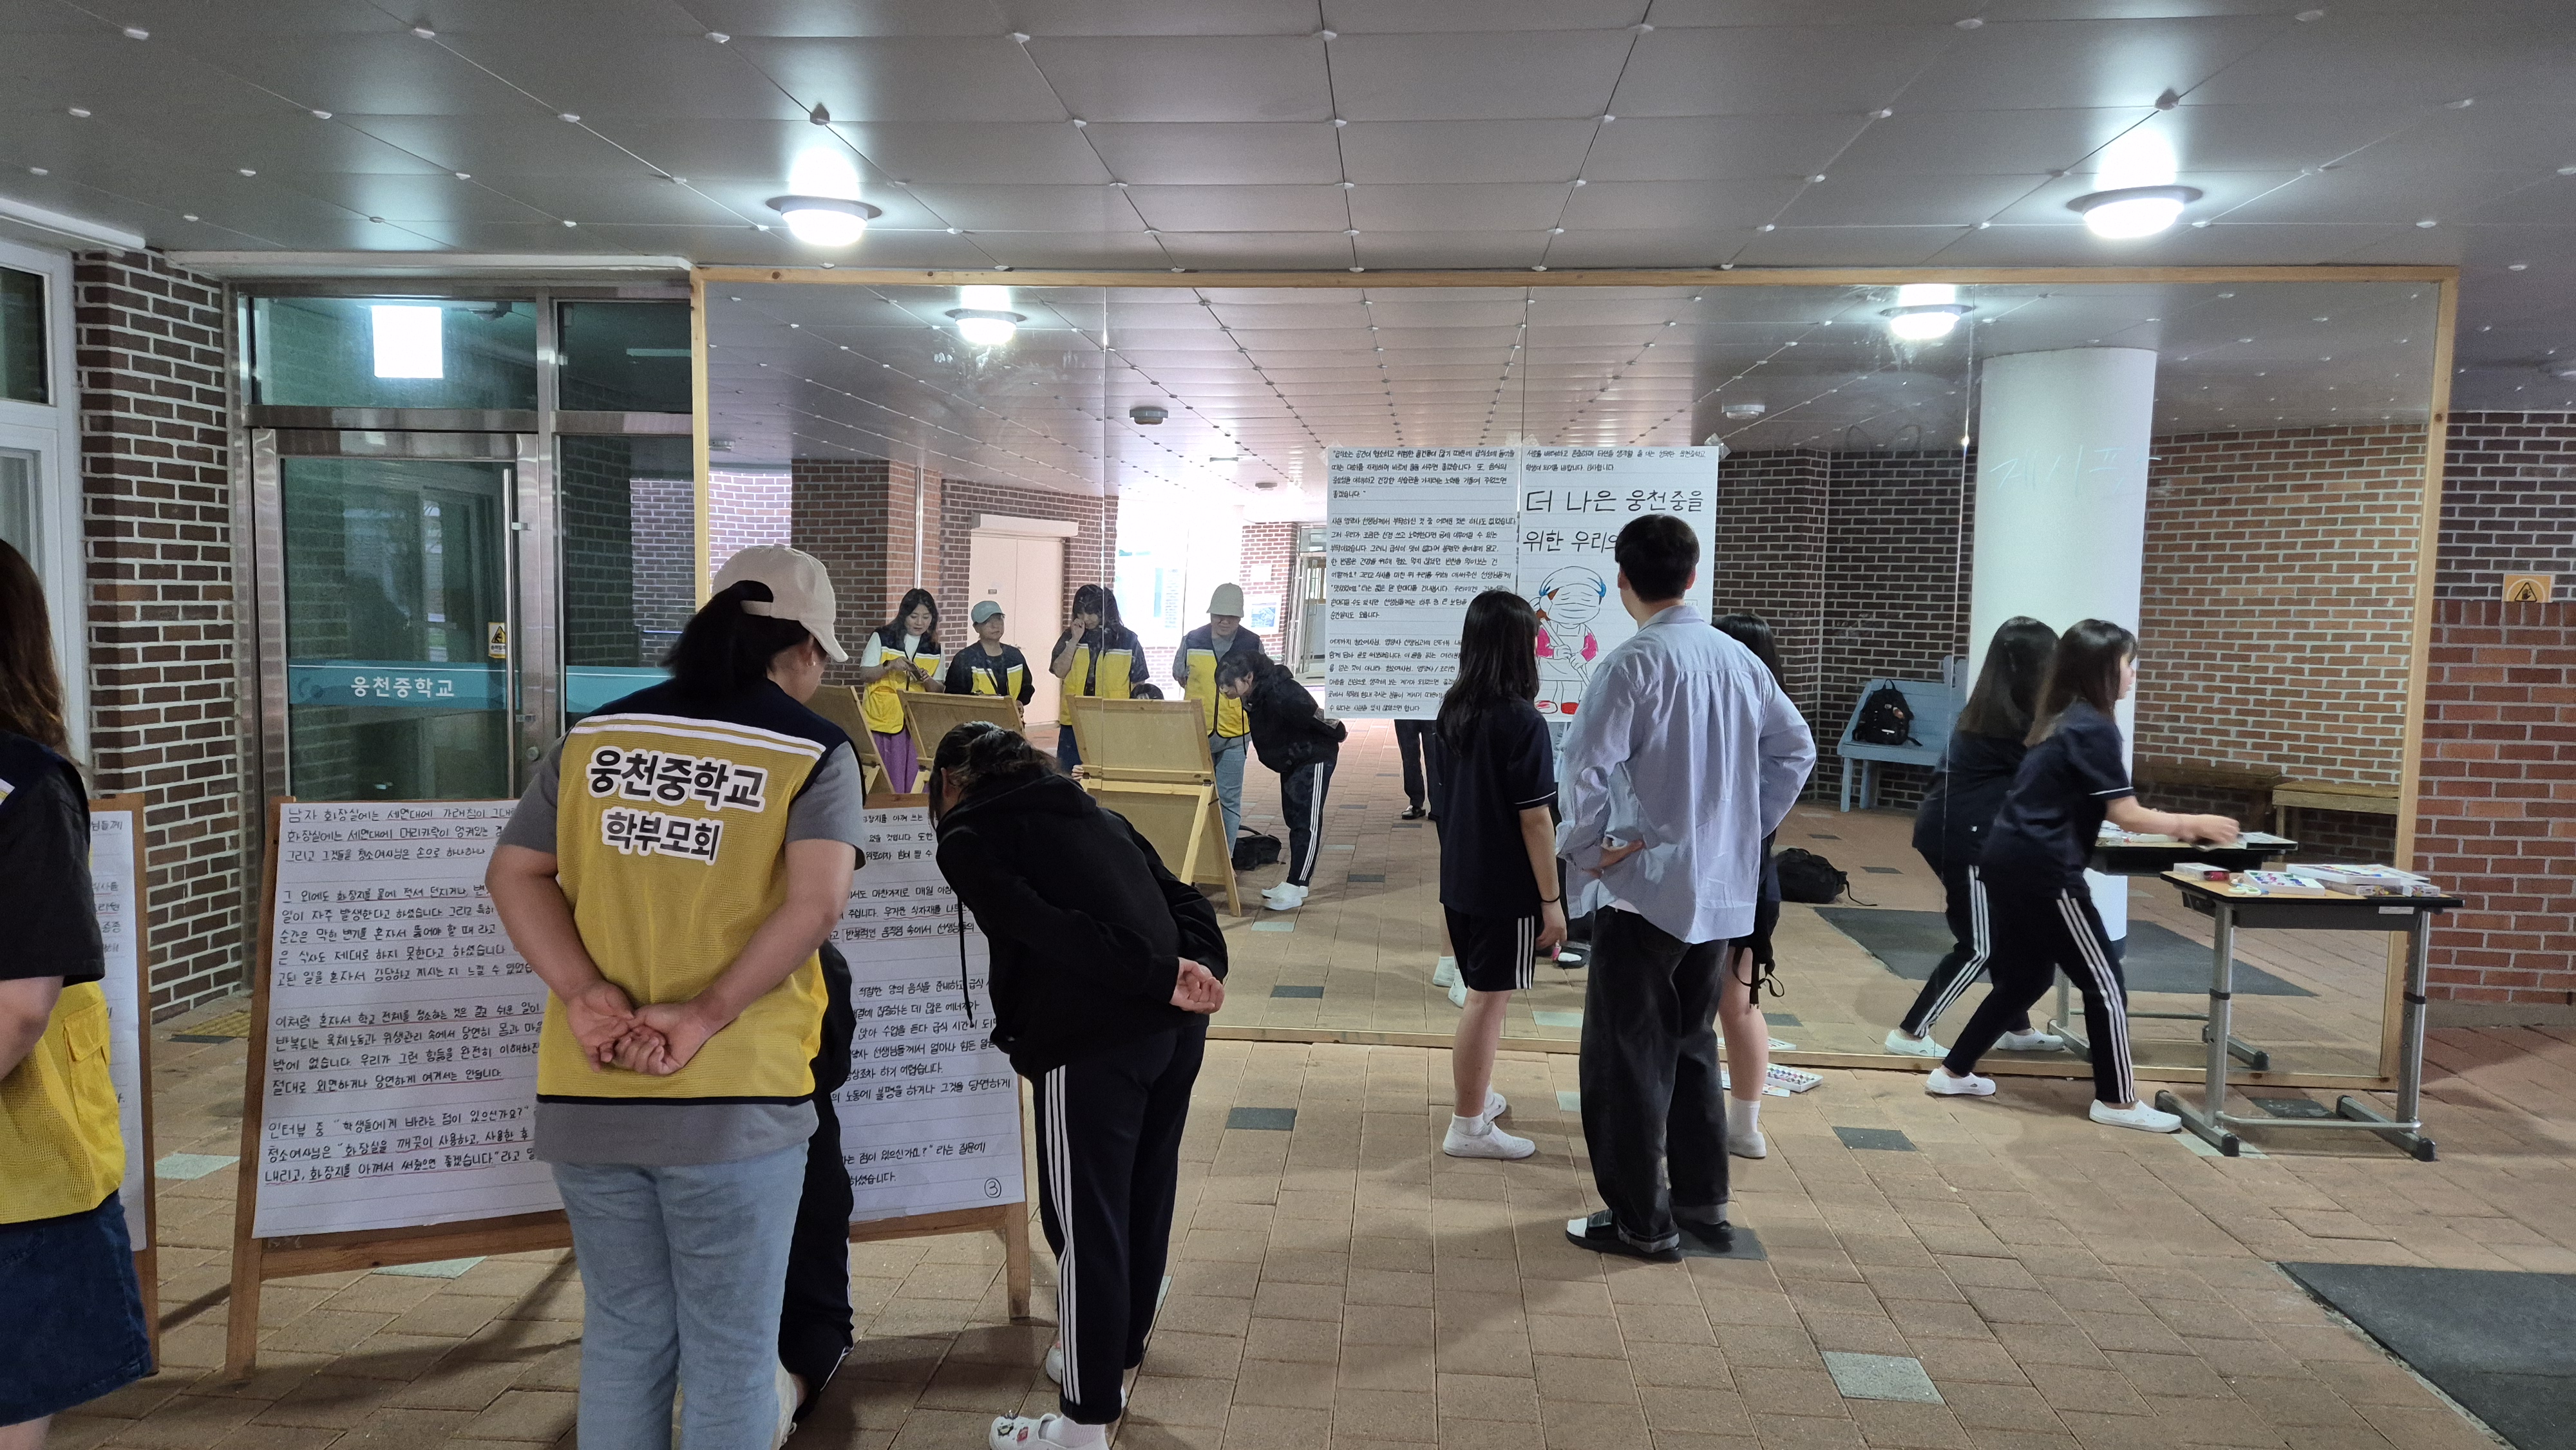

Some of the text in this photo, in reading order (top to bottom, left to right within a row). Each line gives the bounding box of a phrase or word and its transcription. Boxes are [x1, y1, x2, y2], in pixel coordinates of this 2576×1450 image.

[1526, 489, 1704, 513] 더 나은 웅천중을
[1522, 530, 1564, 552] 위한
[351, 676, 455, 698] 웅천중학교
[591, 750, 763, 807] 웅천중학교
[289, 808, 317, 823] 남자
[324, 809, 380, 822] 화장실에는
[444, 808, 485, 819] 가래침이
[287, 829, 343, 843] 화장실에는
[401, 826, 449, 838] 머리카락이
[607, 812, 720, 861] 학부모회
[285, 847, 486, 862] 그리고 그것들을 청소여사님은 손으로 하나하나
[283, 890, 291, 903] 그
[301, 890, 330, 901] 외에도
[337, 889, 371, 901] 화장지를
[377, 889, 397, 900] 물에
[872, 886, 933, 898] 마찬가지로 매일
[282, 910, 304, 923] 일이
[312, 910, 332, 921] 자주
[340, 909, 390, 921] 발생한다고
[477, 903, 494, 915] 특히
[280, 924, 495, 944] 순간은 막힌 변기를 혼자서 할 때 라고
[907, 924, 932, 935] 속에서
[299, 950, 326, 964] 식사도
[334, 949, 369, 961] 제대로
[375, 948, 397, 960] 하지
[406, 946, 444, 960] 못한다고
[277, 965, 500, 986] 고된 일을 혼자서 감당하고 계시는 지 느낄 수
[889, 983, 904, 995] 양의
[907, 982, 931, 994] 음식을
[969, 978, 983, 991] 급식
[276, 1015, 310, 1029] 이처럼
[319, 1012, 350, 1028] 혼자서
[358, 1012, 375, 1025] 학교
[382, 1010, 409, 1023] 전체를
[417, 1009, 448, 1021] 청소하는
[454, 1006, 467, 1018] 것은
[497, 1004, 514, 1015] 쉬운
[521, 1001, 539, 1015] 일이
[877, 1002, 942, 1018] 집중하는 데 많은
[276, 1035, 319, 1052] 반복되는
[383, 1030, 422, 1044] 위생관리
[428, 1030, 455, 1040] 속에서
[462, 1026, 490, 1040] 당연히
[499, 1022, 519, 1036] 몸과
[882, 1024, 905, 1037] 수업을
[933, 1021, 948, 1033] 급식
[273, 1059, 299, 1072] 밖에
[361, 1053, 391, 1066] 우리가
[398, 1051, 418, 1064] 그런
[461, 1046, 491, 1060] 완전히
[873, 1043, 925, 1058] 선생님들께서
[960, 1040, 976, 1051] 힘든
[880, 1066, 896, 1077] 하기
[272, 1080, 307, 1096] 절대로
[375, 1074, 415, 1089] 당연하게
[845, 1078, 1011, 1102] 노동에 불평을 하거나 그것을 당연하게
[269, 1122, 306, 1139] 인터뷰
[316, 1122, 323, 1137] 중
[405, 1116, 436, 1127] 바라는
[442, 1113, 461, 1125] 점이
[268, 1145, 331, 1163] 청소여사님은
[397, 1135, 433, 1149] 깨끗이
[486, 1128, 514, 1142] 사용한
[520, 1127, 529, 1140] 후
[859, 1142, 985, 1163] 점이 질문에
[309, 1163, 350, 1181] 화장지를
[358, 1162, 393, 1175] 아껴서
